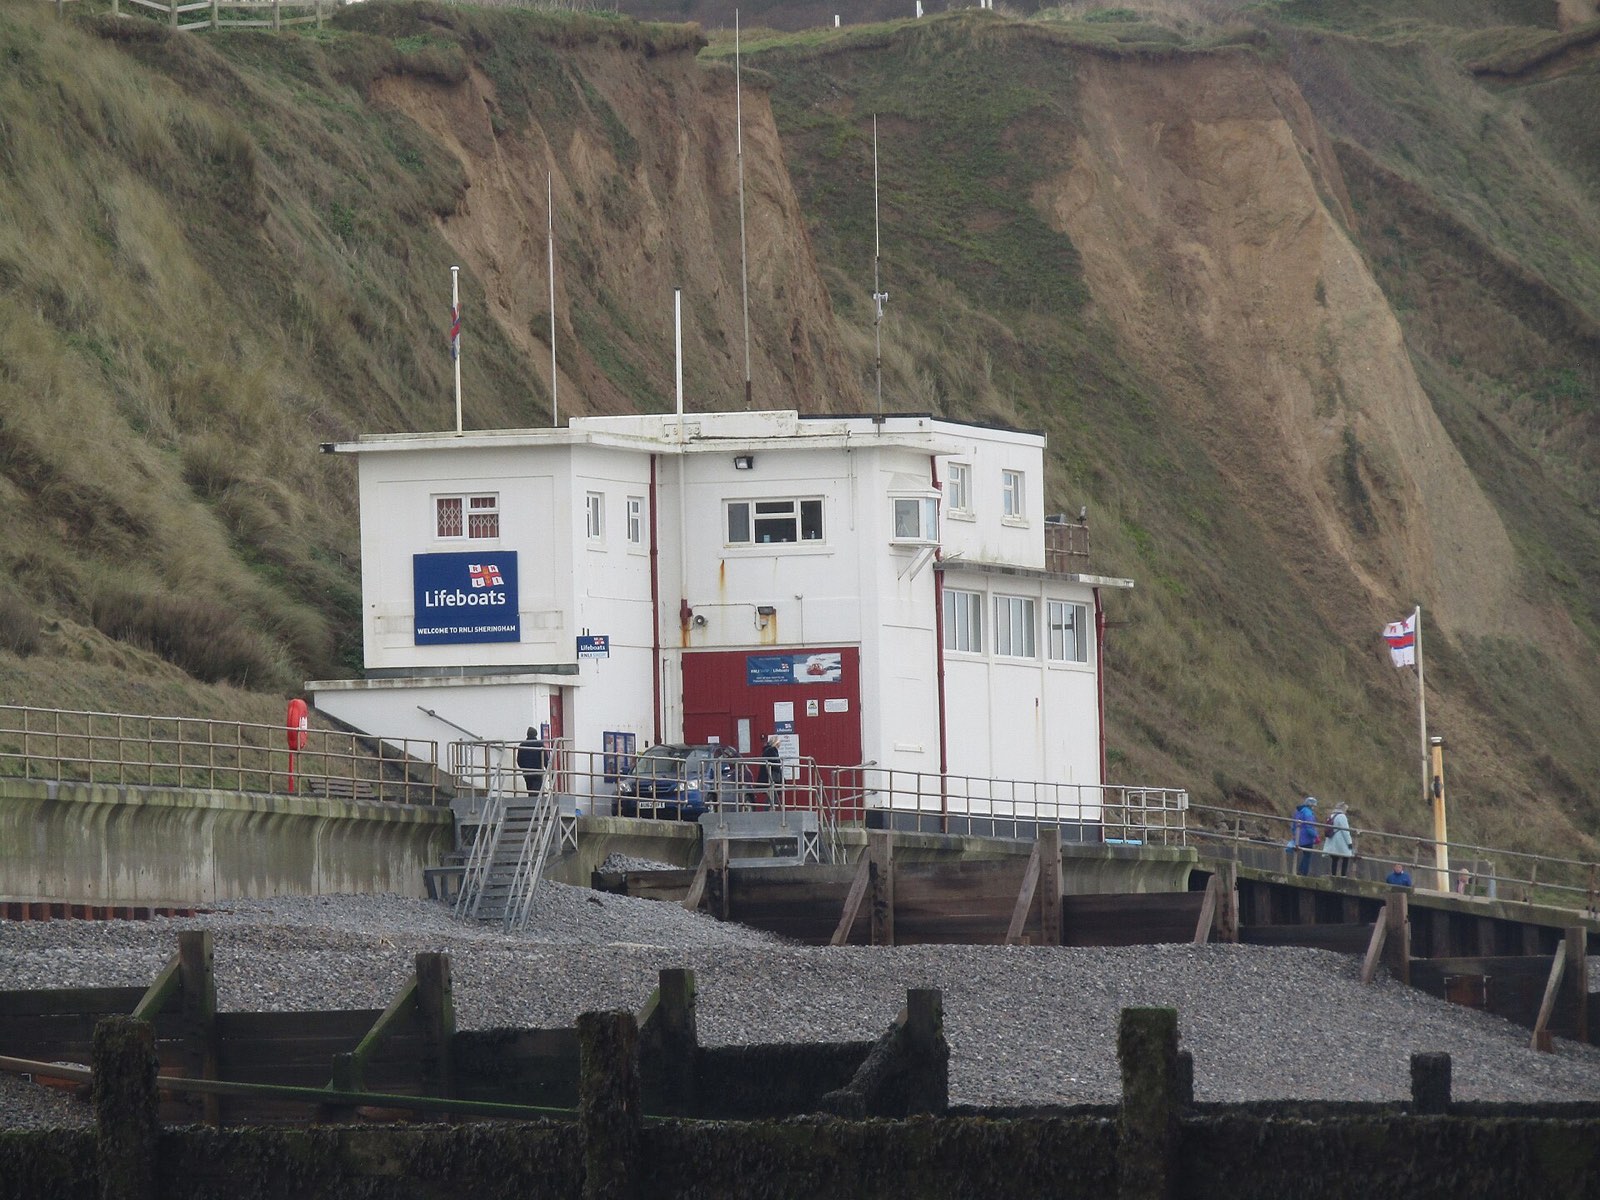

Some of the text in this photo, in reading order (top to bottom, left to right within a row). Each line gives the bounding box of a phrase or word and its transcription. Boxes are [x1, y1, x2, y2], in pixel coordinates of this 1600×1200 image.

[425, 589, 506, 607] Lifeboats
[417, 625, 516, 635] WELCOME TO RNLI SHERINGHAM
